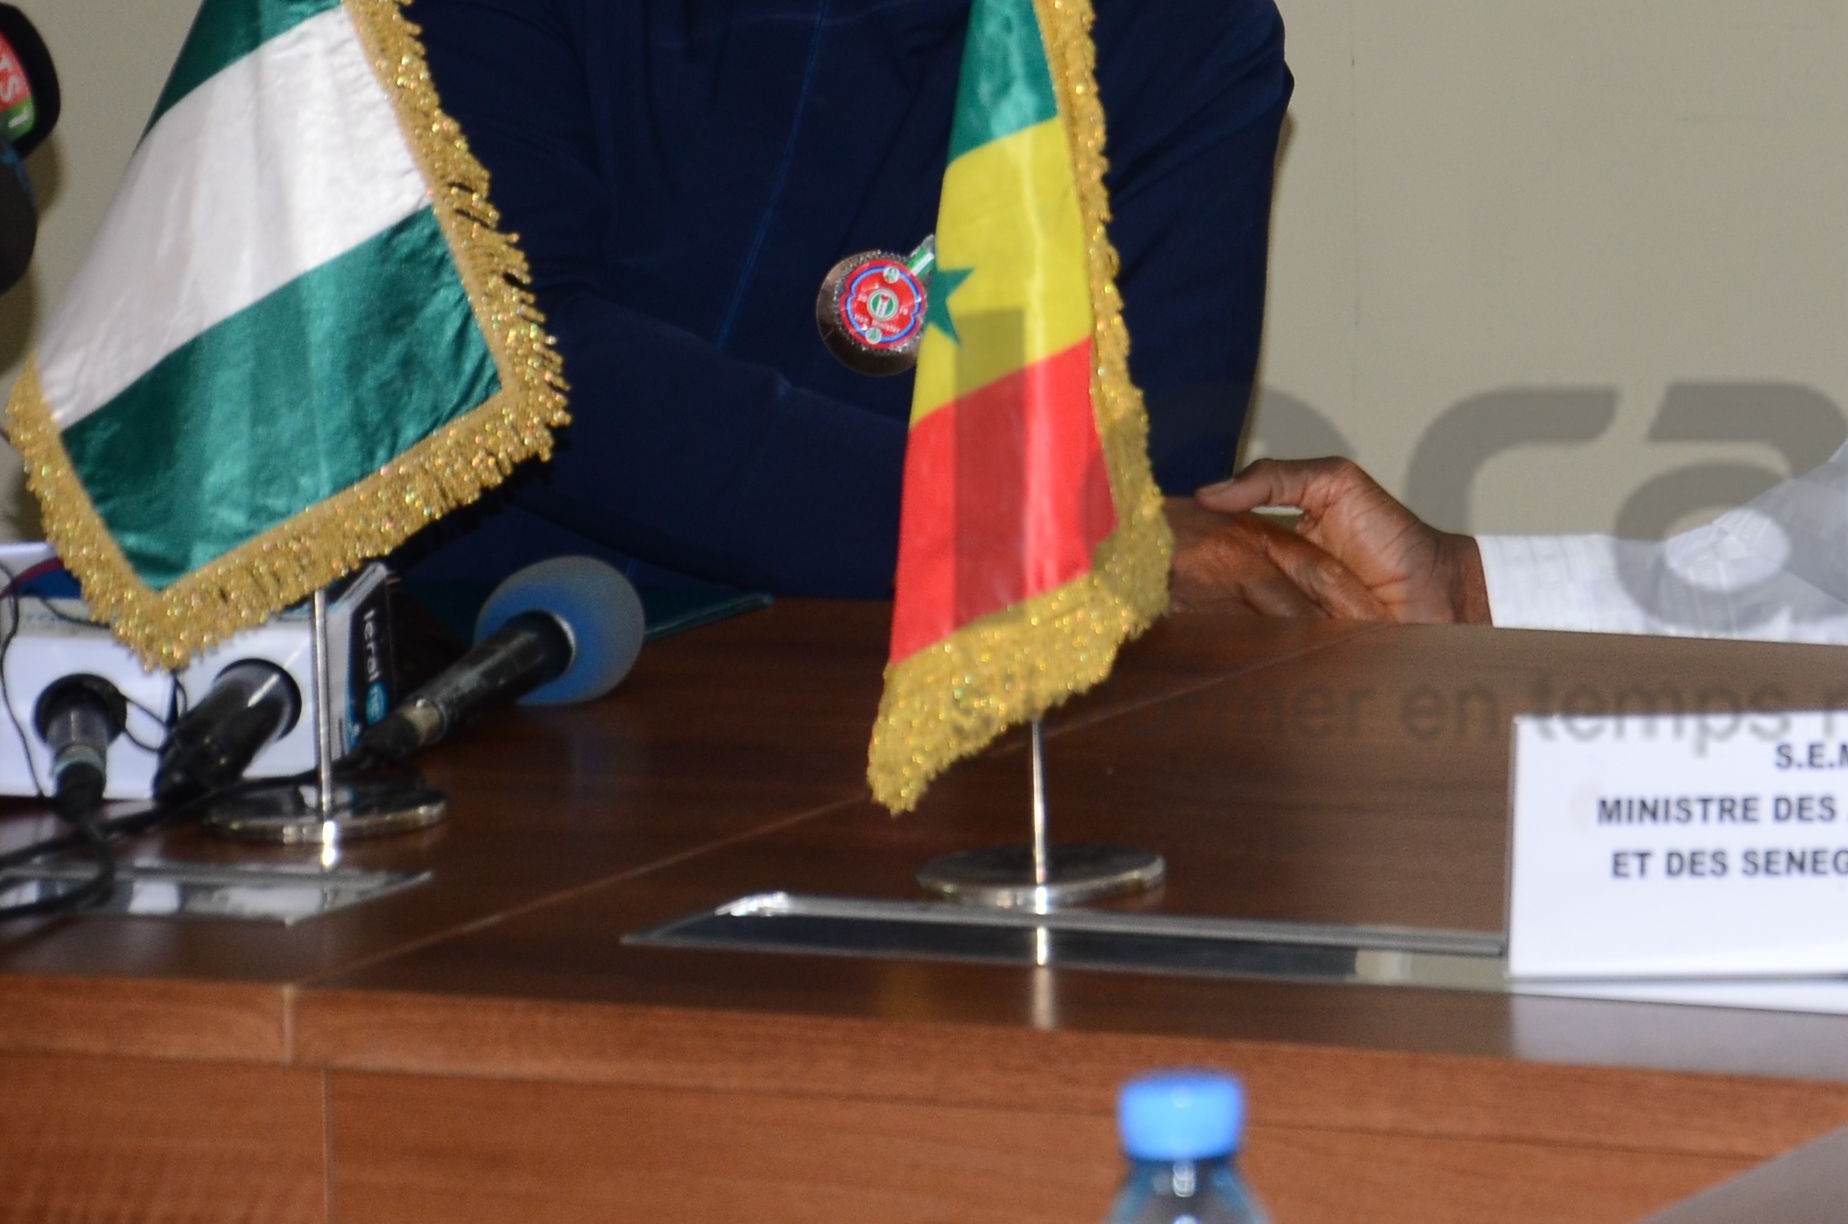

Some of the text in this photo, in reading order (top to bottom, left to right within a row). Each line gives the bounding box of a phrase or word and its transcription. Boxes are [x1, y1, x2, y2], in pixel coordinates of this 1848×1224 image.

[1597, 795, 1760, 826] MINISTRE
[1772, 794, 1838, 824] DES
[1610, 849, 1653, 879] ET
[1664, 849, 1730, 879] DES
